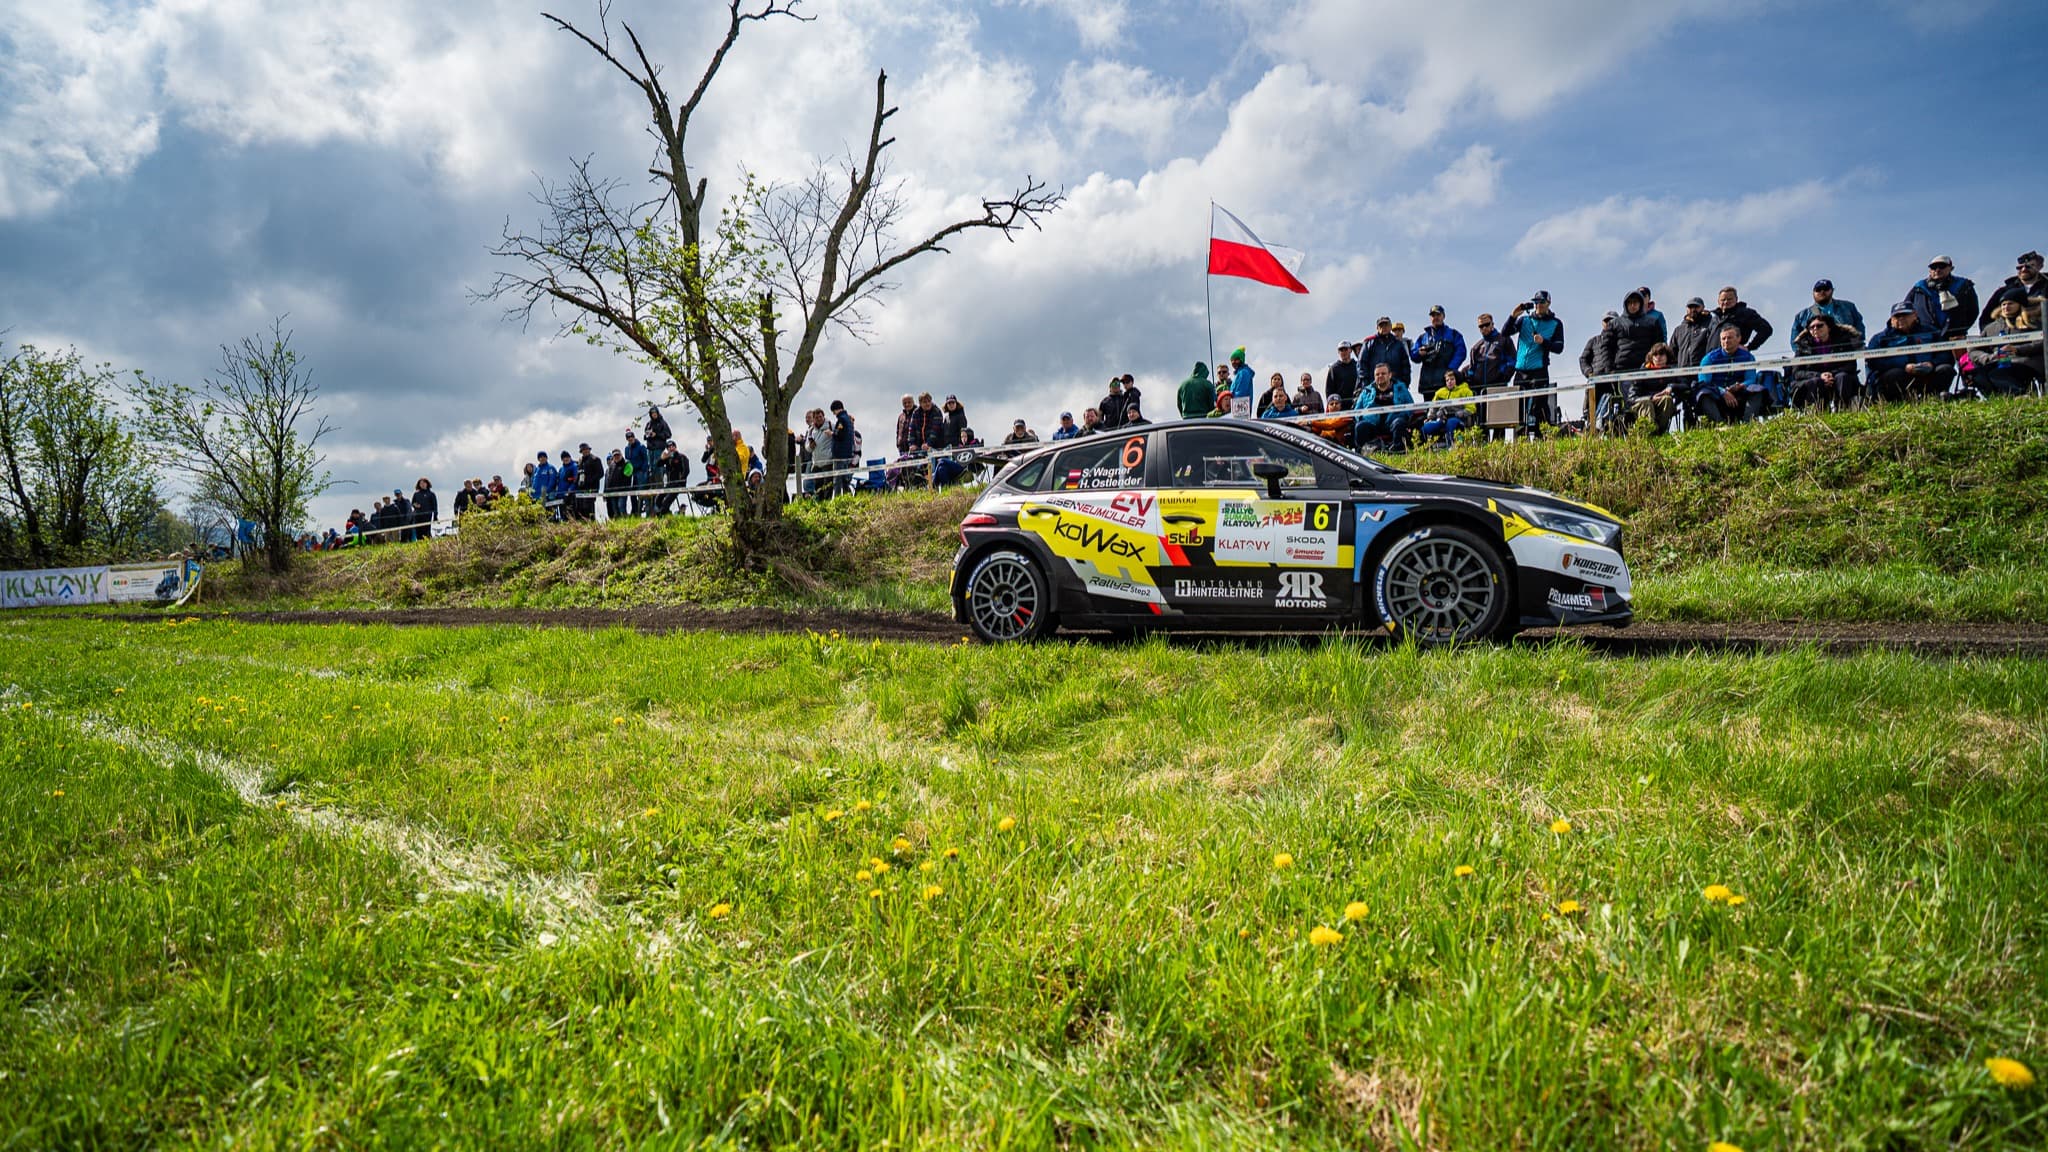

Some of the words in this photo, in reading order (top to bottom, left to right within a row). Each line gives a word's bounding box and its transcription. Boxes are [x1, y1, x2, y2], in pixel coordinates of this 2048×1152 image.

[1122, 435, 1146, 468] 6
[1082, 468, 1092, 477] S.
[1093, 467, 1132, 478] Wagner
[1079, 479, 1090, 488] H.
[1091, 476, 1143, 489] Ostlender
[1313, 504, 1330, 530] 6
[1222, 520, 1262, 528] KLATOVY
[1218, 538, 1271, 551] KLATOVY
[6, 572, 103, 599] KLATOVY
[1192, 580, 1263, 588] AUTOLAND
[1191, 587, 1263, 599] HINTERLEITNER
[1548, 588, 1593, 607] PRAMMER
[1275, 598, 1327, 609] MOTORS
